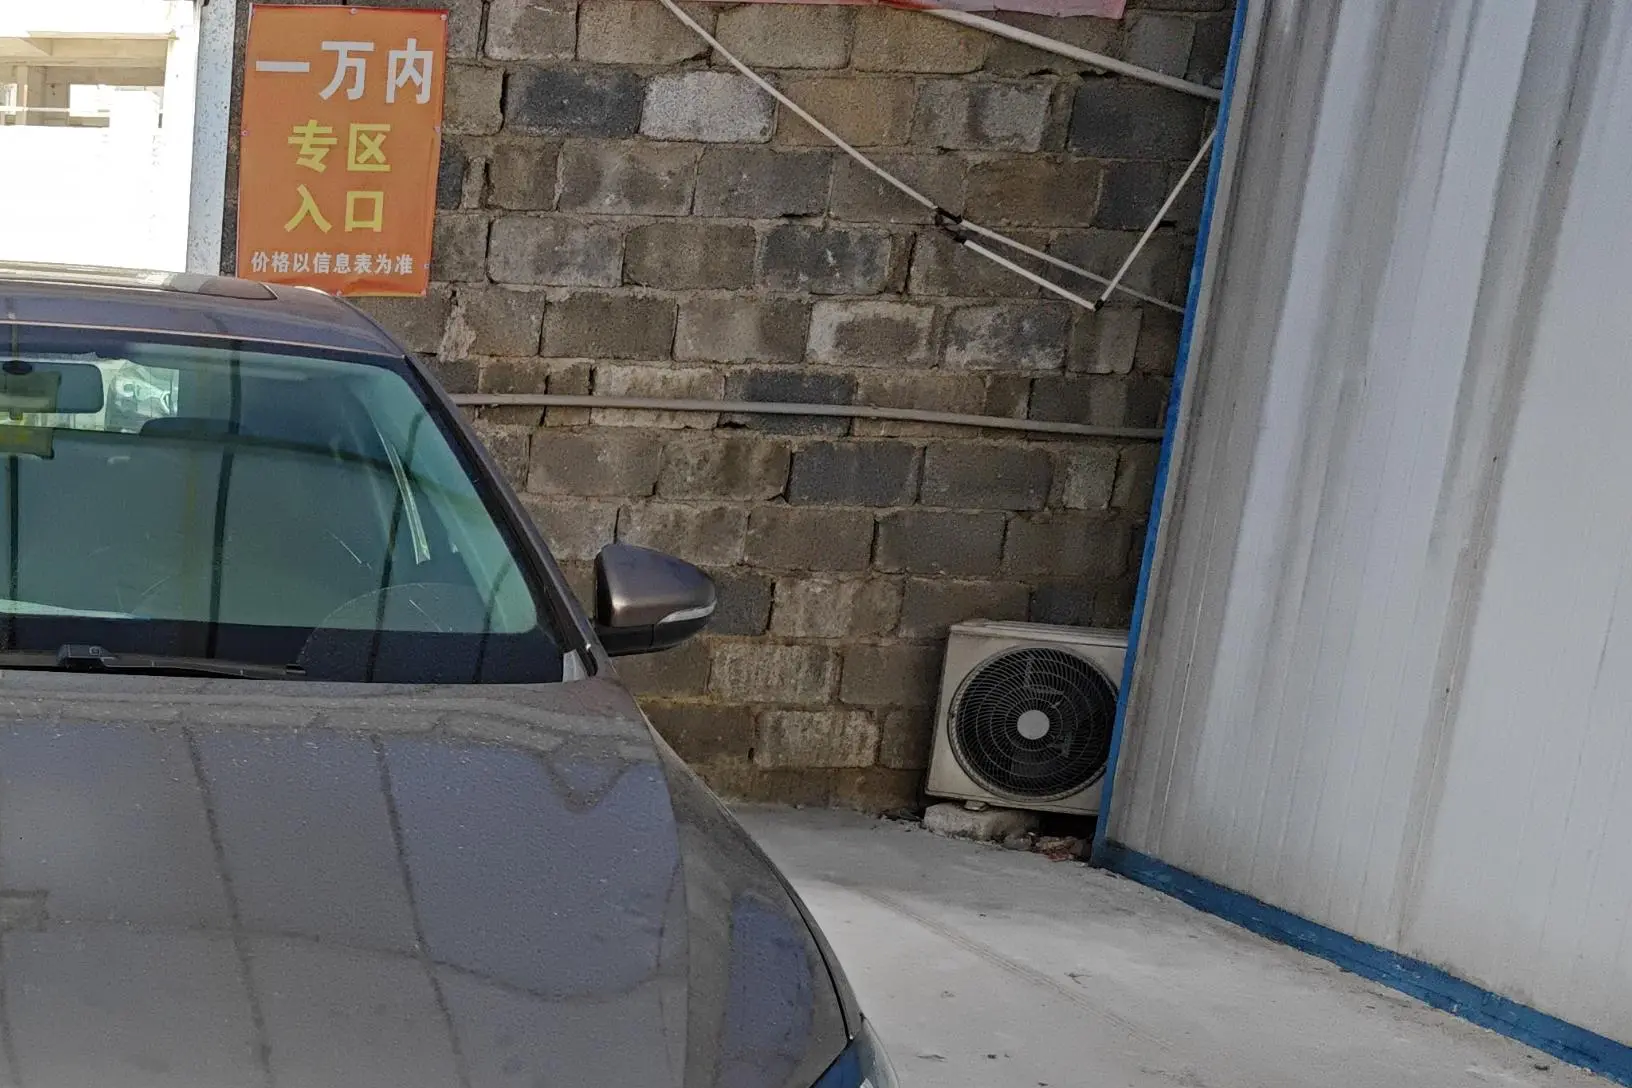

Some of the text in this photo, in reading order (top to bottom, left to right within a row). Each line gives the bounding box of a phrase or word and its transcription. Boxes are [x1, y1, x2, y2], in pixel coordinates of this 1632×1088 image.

[256, 38, 433, 104] 一万内
[288, 119, 391, 173] 专区
[284, 184, 384, 233] 入口
[251, 252, 413, 275] 价格以信息表为准
